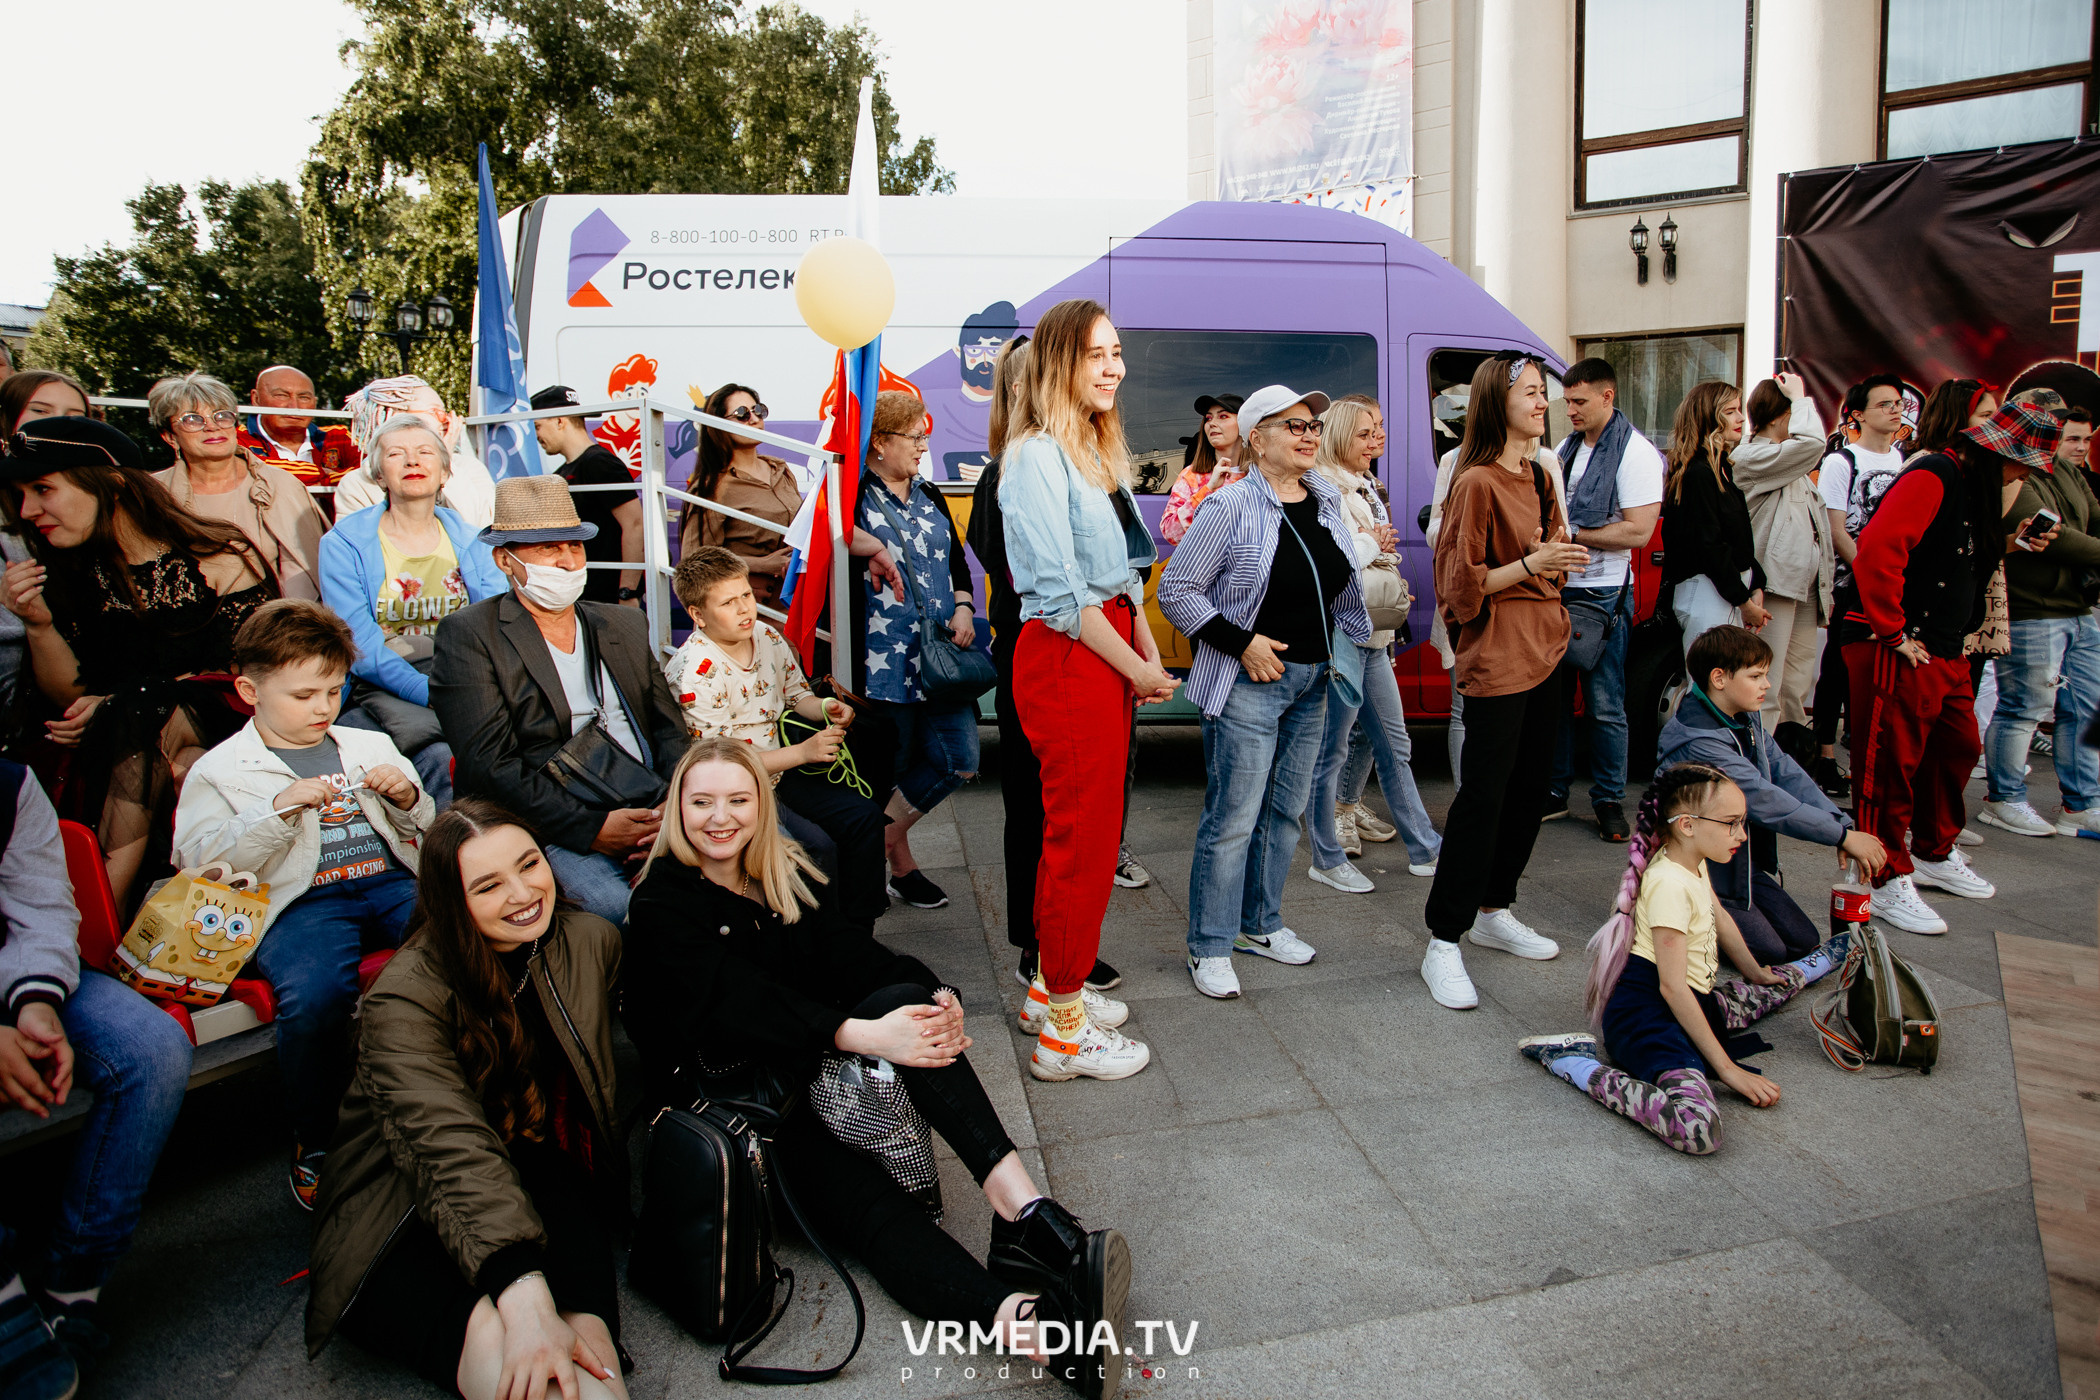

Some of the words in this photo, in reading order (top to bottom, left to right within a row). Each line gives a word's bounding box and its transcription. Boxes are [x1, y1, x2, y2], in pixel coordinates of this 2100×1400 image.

[650, 229, 798, 244] 8-800-100-0-800
[622, 262, 796, 291] Ростелек
[320, 827, 347, 844] AND
[319, 839, 382, 863] ampionship
[314, 870, 342, 885] OAD
[347, 860, 385, 879] RACING
